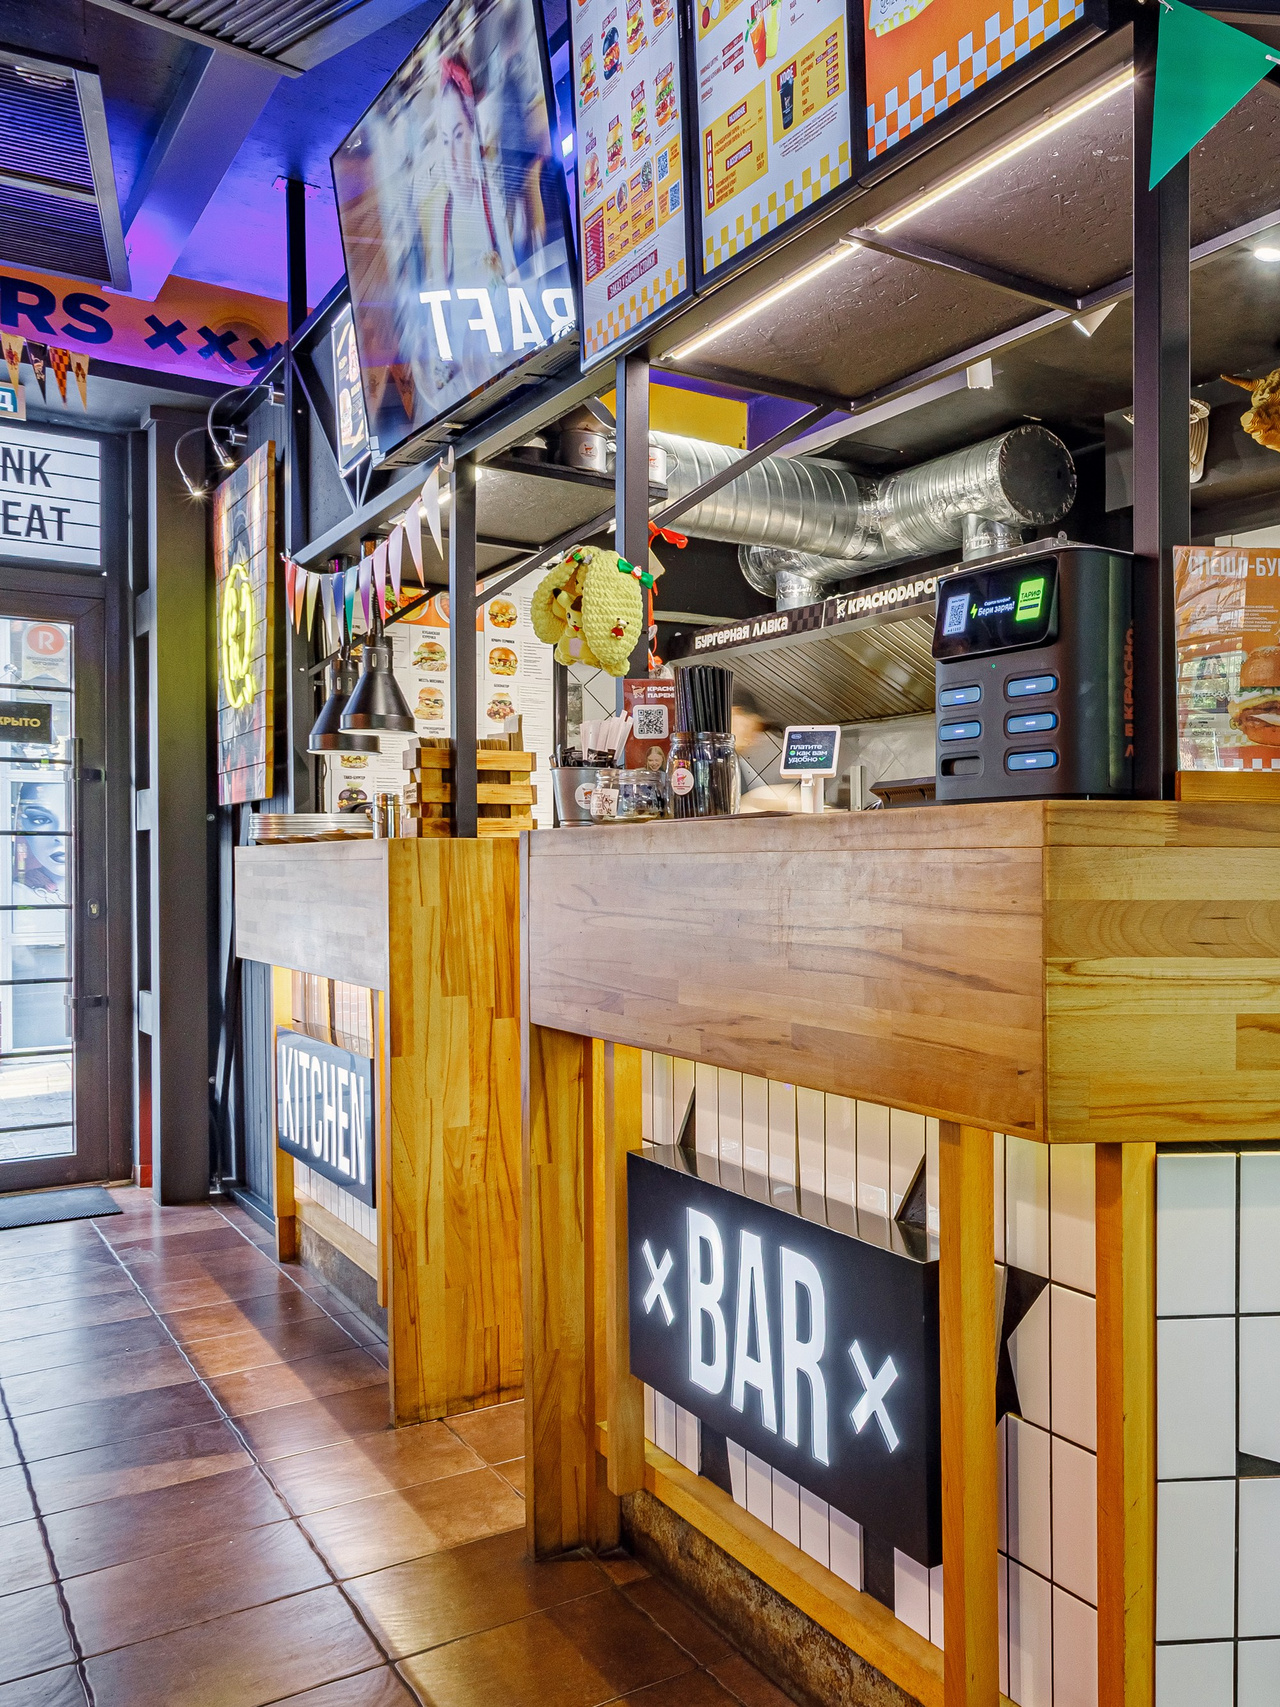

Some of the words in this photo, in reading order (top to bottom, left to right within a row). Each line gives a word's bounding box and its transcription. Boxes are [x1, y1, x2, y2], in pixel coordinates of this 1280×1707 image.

[780, 65, 794, 85] КОФЕ
[2, 447, 52, 488] NK
[2, 501, 70, 541] EAT
[978, 606, 994, 617] Бери
[994, 601, 1015, 614] заряд!
[1021, 590, 1041, 599] ТАРИФ
[788, 755, 818, 764] удобно
[282, 1044, 366, 1186] KITCHEN
[686, 1206, 830, 1467] BAR
